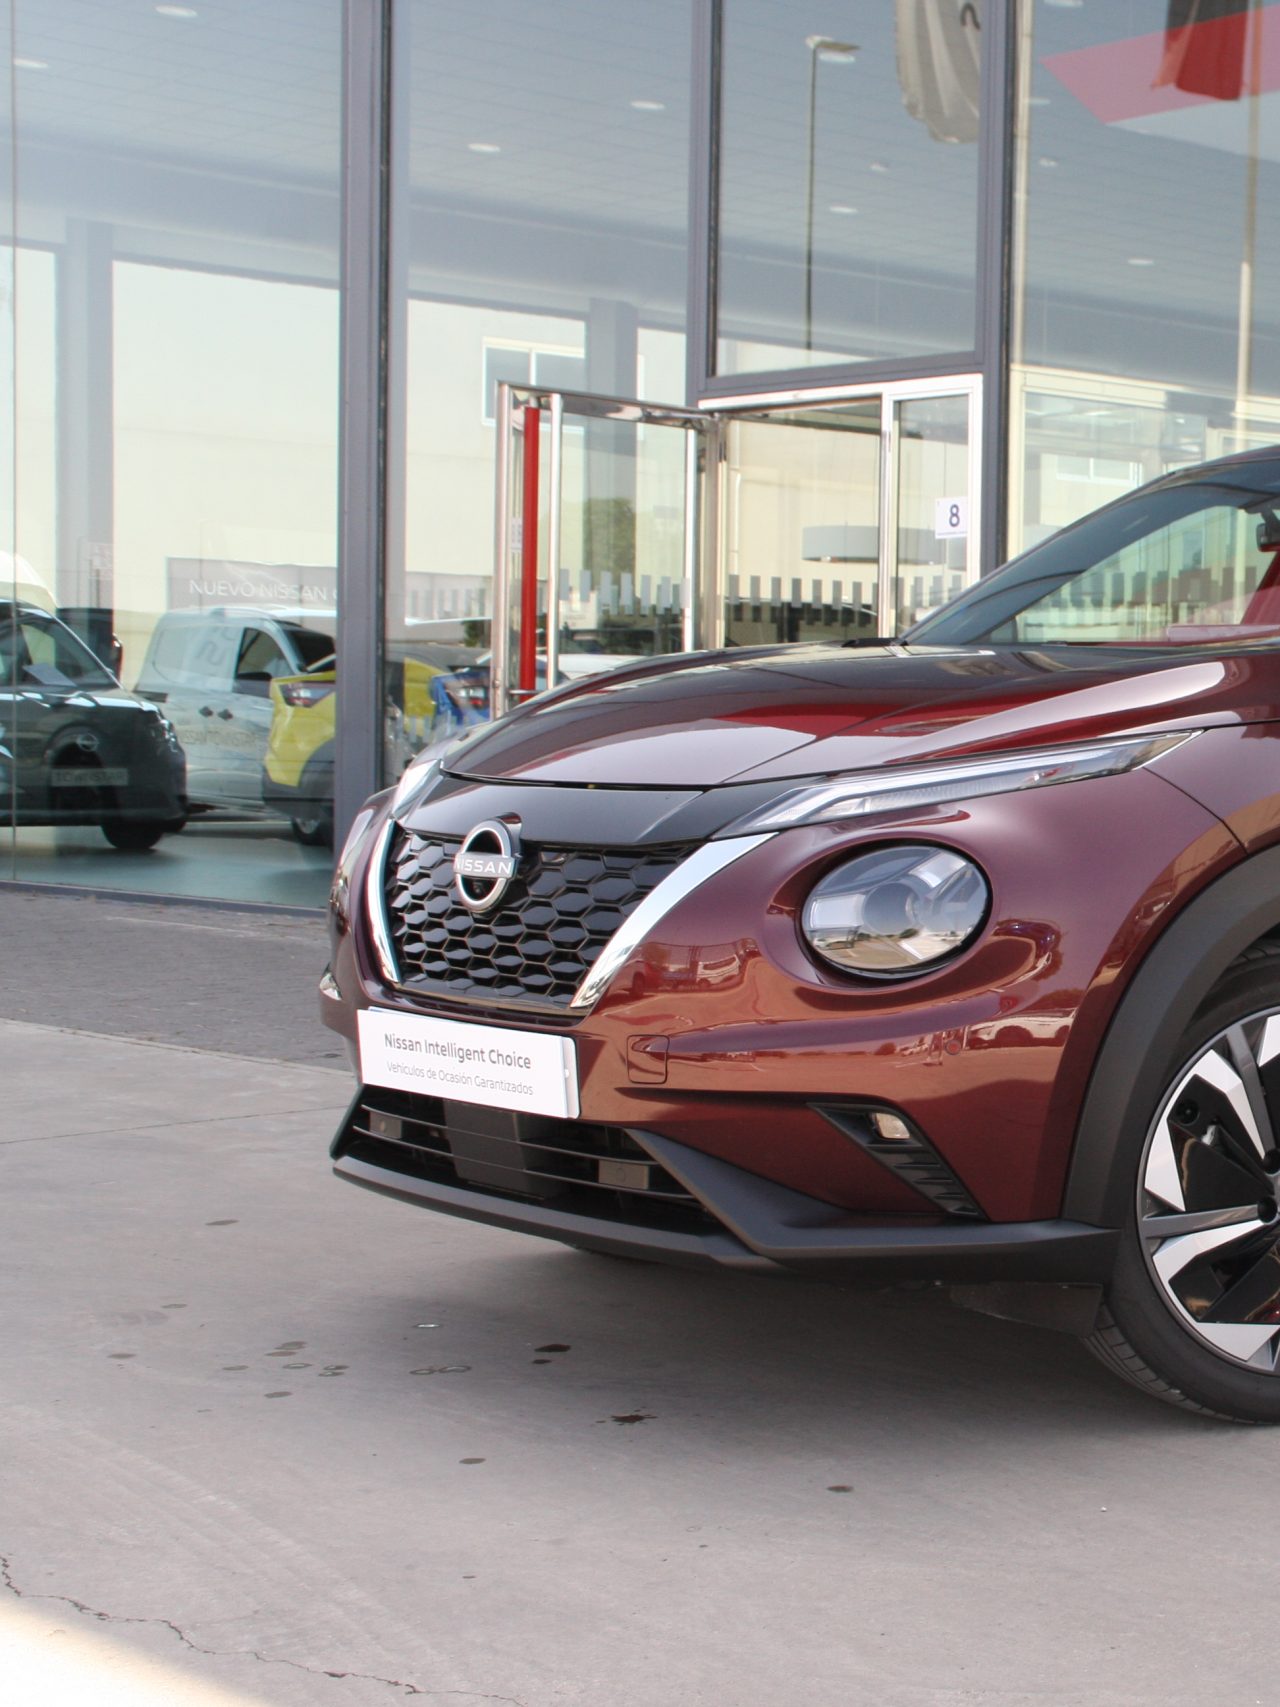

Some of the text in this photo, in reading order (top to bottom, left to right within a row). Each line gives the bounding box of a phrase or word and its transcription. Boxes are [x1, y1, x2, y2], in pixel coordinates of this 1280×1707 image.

[949, 504, 960, 528] 8
[189, 579, 255, 598] NUEVO
[260, 583, 327, 601] NISSAN
[455, 856, 512, 875] NISSAN
[384, 1033, 532, 1069] Nissan Intelligent Choice
[426, 1067, 437, 1080] de
[474, 1075, 534, 1096] Garantizados
